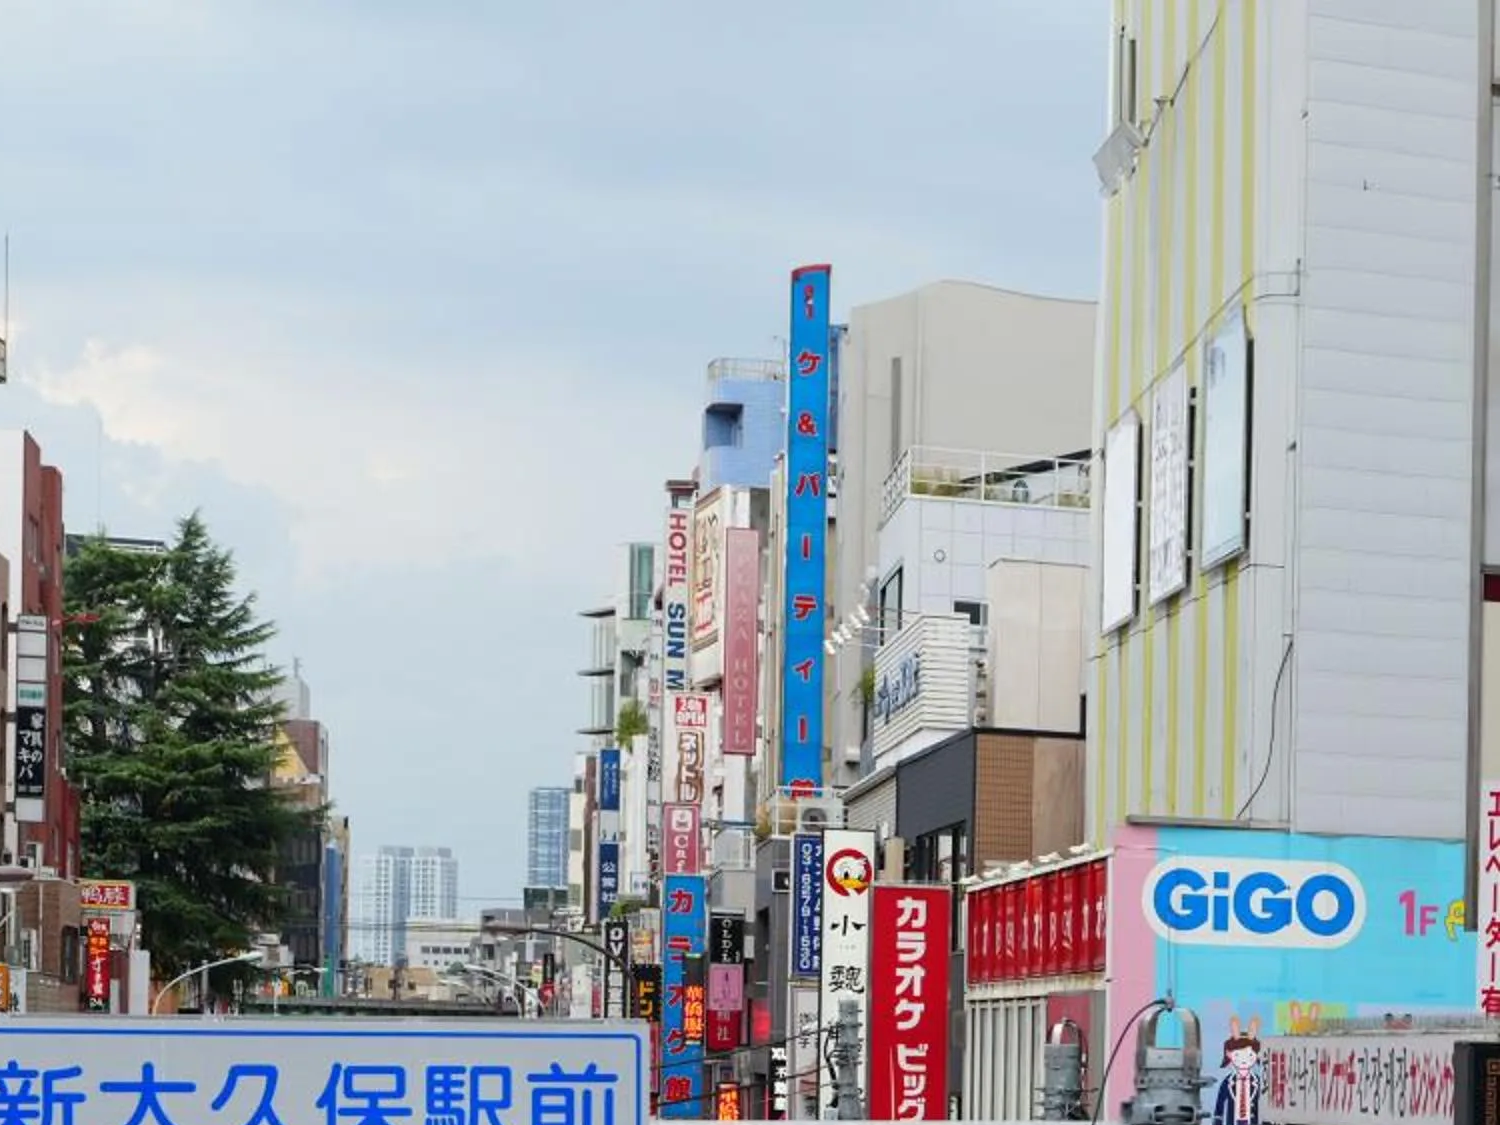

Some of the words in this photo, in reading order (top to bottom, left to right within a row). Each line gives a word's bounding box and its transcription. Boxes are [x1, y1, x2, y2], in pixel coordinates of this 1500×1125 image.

[668, 513, 688, 587] HOTEL
[667, 602, 686, 659] SUN
[1153, 867, 1356, 937] GiGO
[1398, 889, 1440, 937] 1F
[895, 897, 928, 1032] カラオケ
